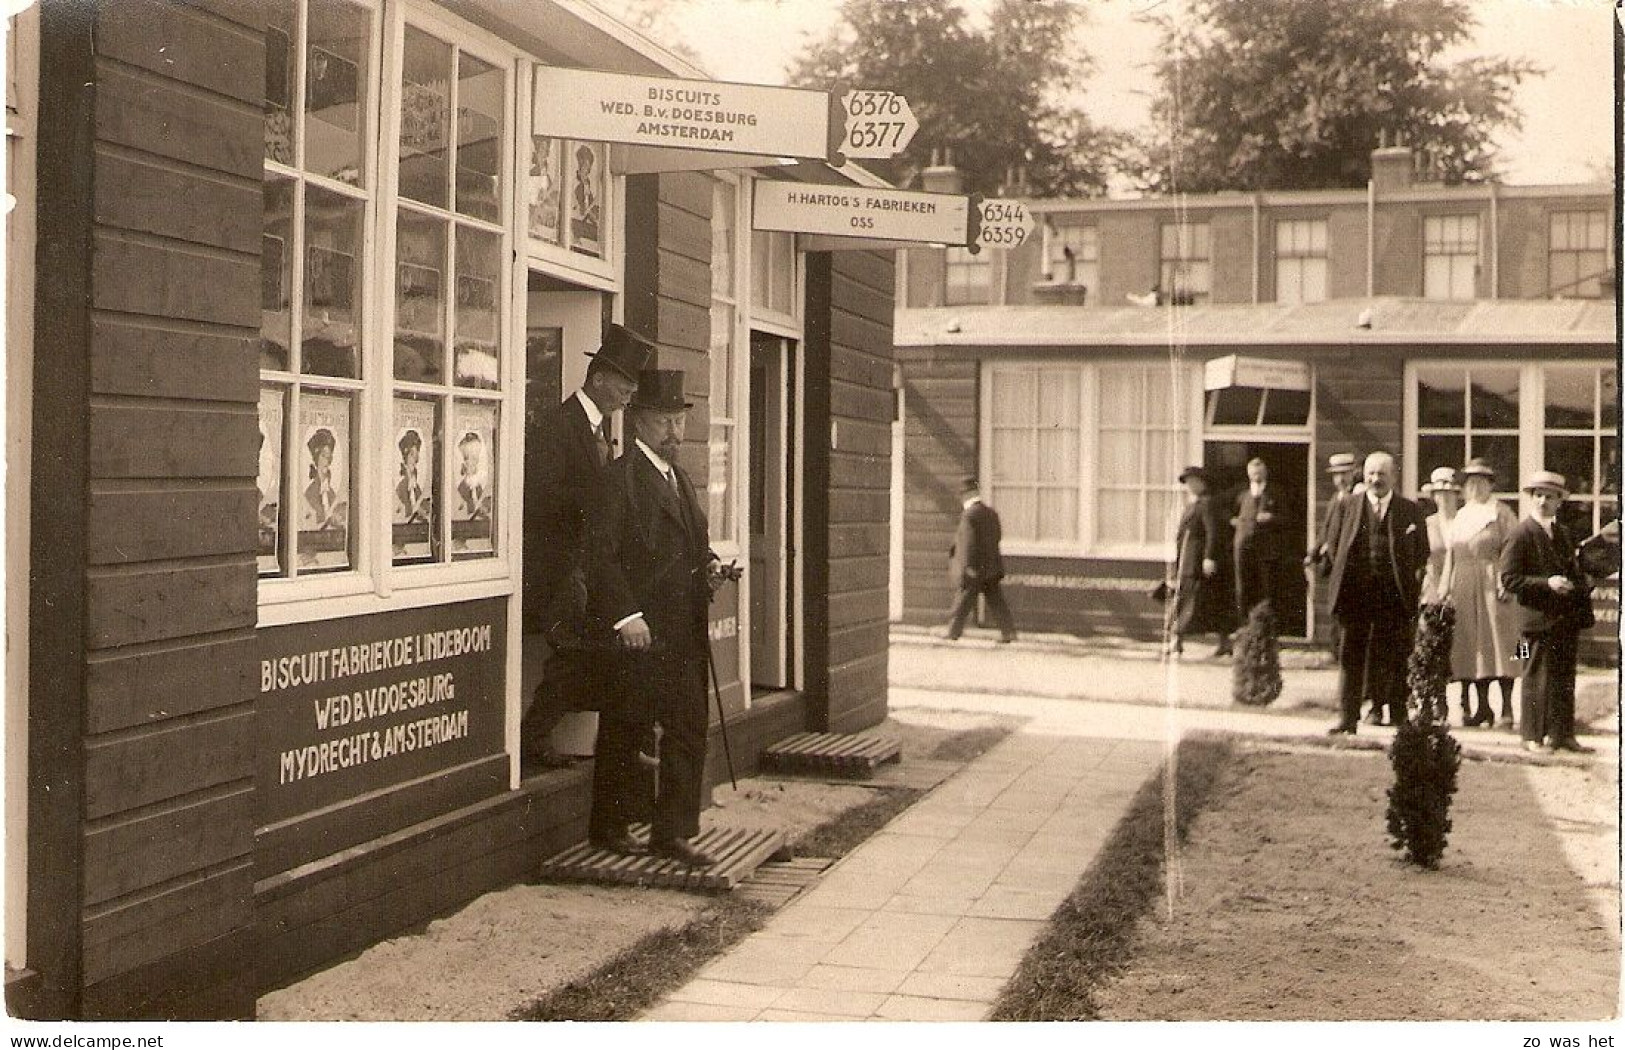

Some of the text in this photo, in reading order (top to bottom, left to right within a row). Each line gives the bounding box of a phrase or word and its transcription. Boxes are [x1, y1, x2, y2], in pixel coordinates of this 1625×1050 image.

[648, 87, 721, 106] BISCUITS
[849, 91, 901, 117] 6376
[600, 101, 638, 116] WED.
[636, 122, 734, 142] AMSTERDAM
[849, 121, 906, 149] 6377
[866, 198, 936, 214] FABRIEKEN
[984, 204, 1024, 223] 6344
[850, 216, 874, 229] OSS
[982, 226, 1026, 246] 6359
[416, 624, 491, 664] LINDEBOOM
[383, 710, 469, 758] AMSTERDAM
